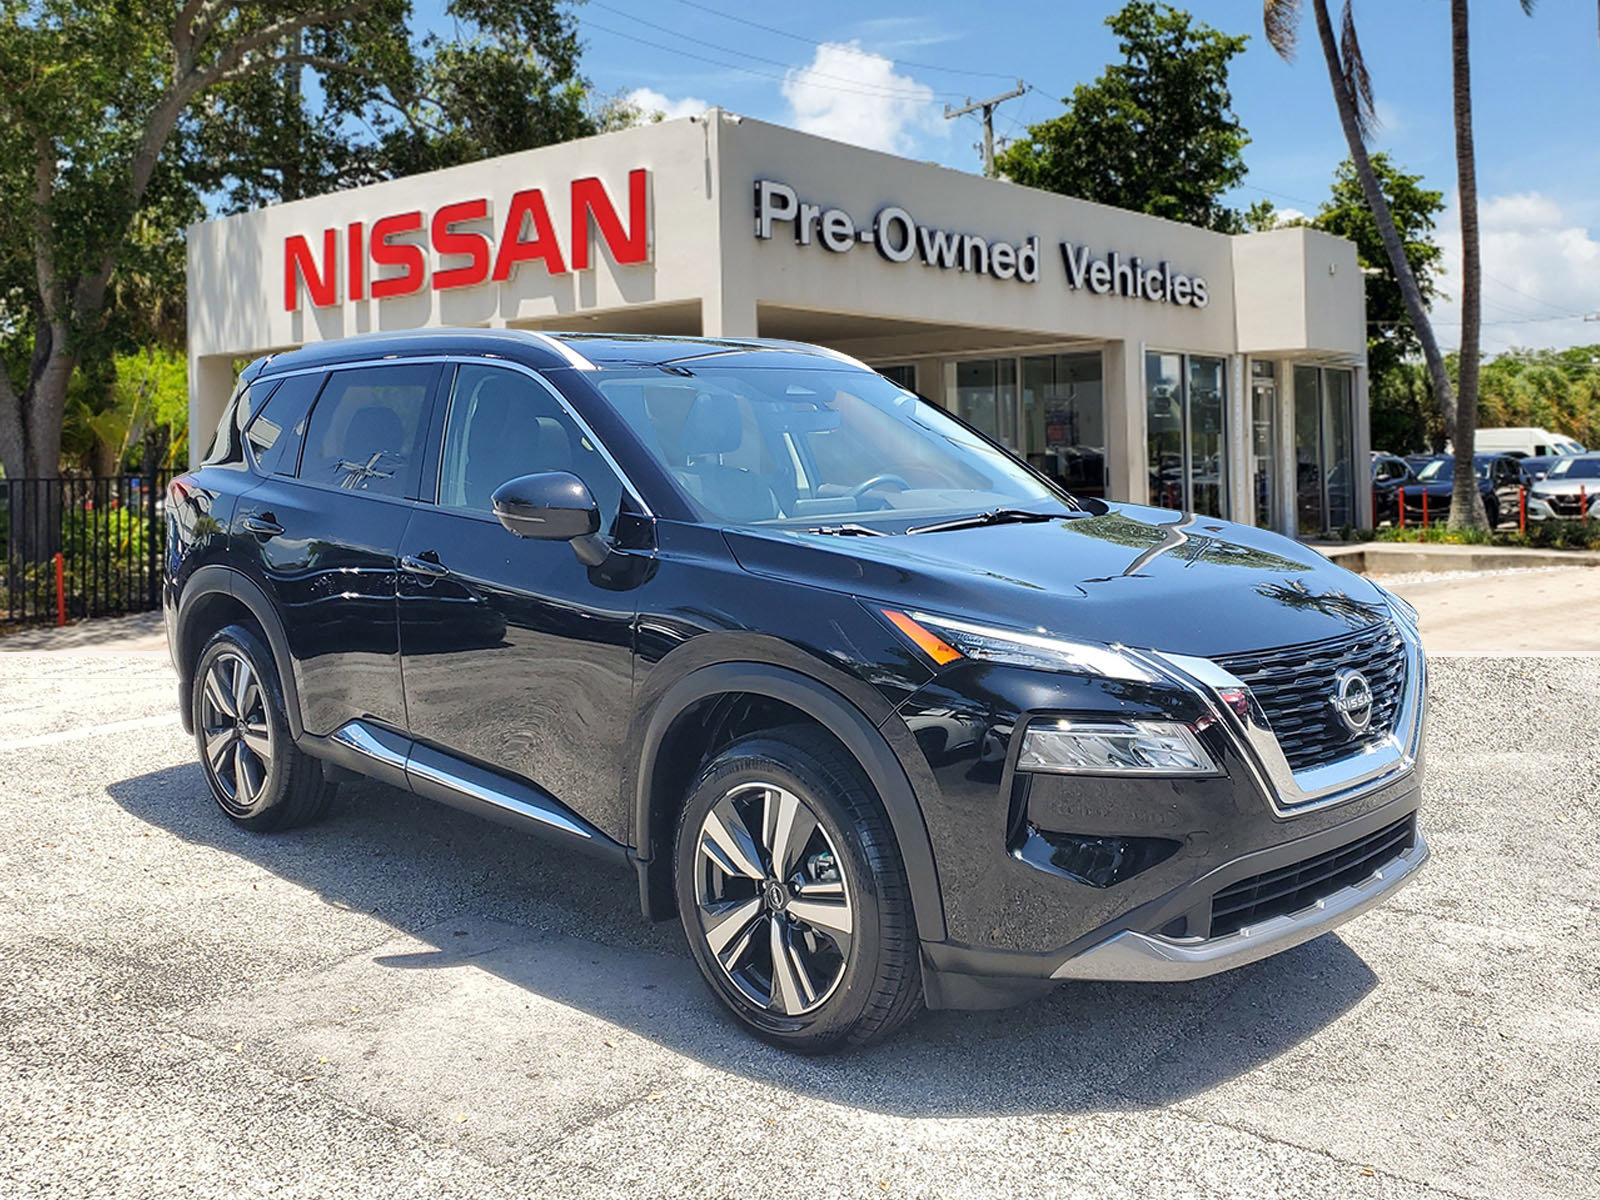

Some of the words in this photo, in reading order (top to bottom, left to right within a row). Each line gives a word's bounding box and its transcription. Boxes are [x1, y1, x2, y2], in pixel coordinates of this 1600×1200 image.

[284, 169, 647, 311] NISSAN
[755, 180, 1040, 283] Pre-Owned
[1062, 241, 1208, 308] Vehicles
